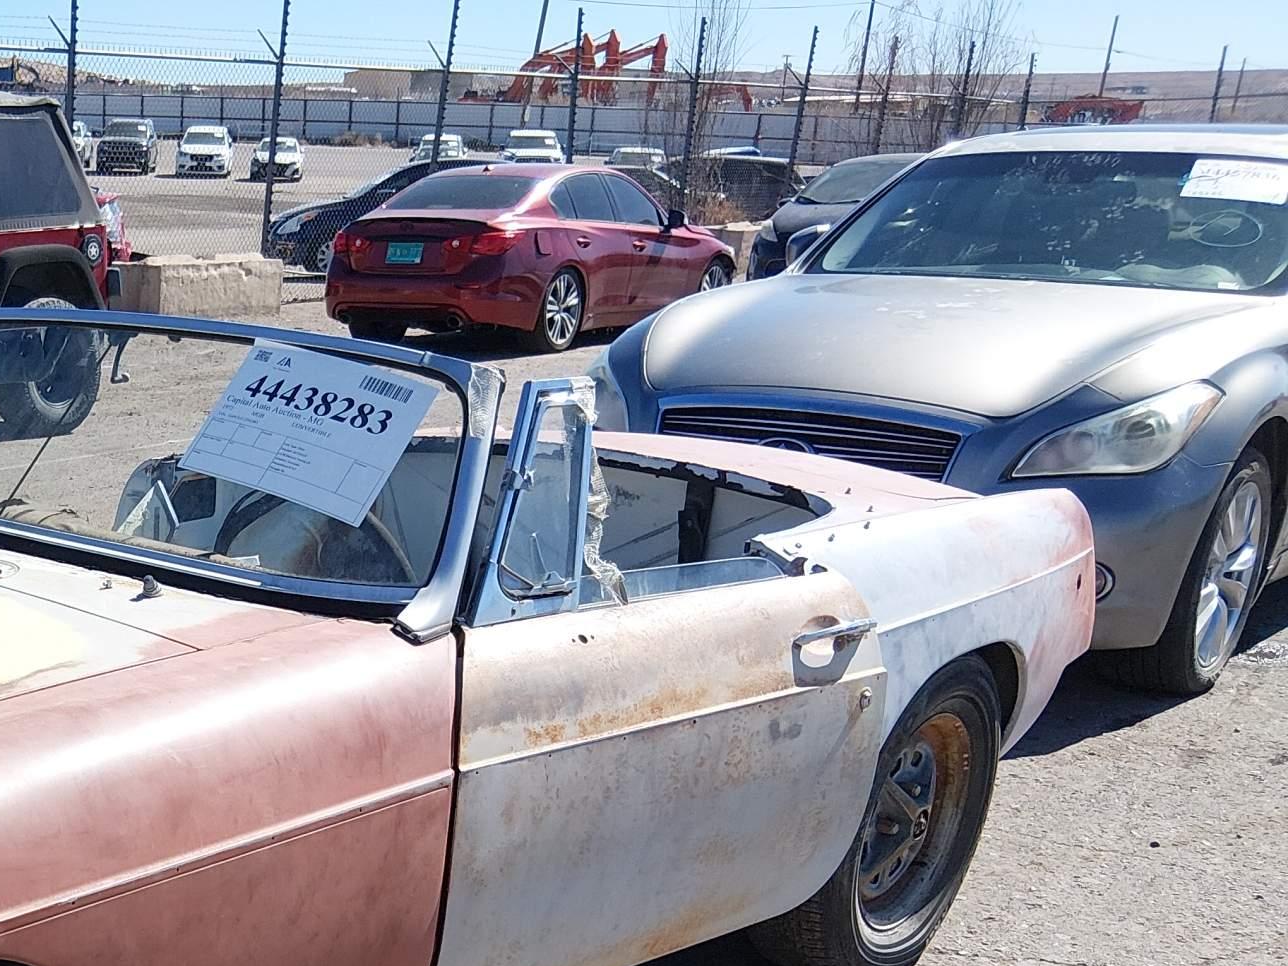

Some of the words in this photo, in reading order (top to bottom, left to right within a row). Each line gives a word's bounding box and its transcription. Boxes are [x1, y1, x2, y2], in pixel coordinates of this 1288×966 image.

[226, 395, 253, 406] Capital
[253, 401, 271, 411] Auto
[272, 406, 301, 419] Auction
[307, 415, 324, 426] MG
[245, 375, 393, 435] 44438283
